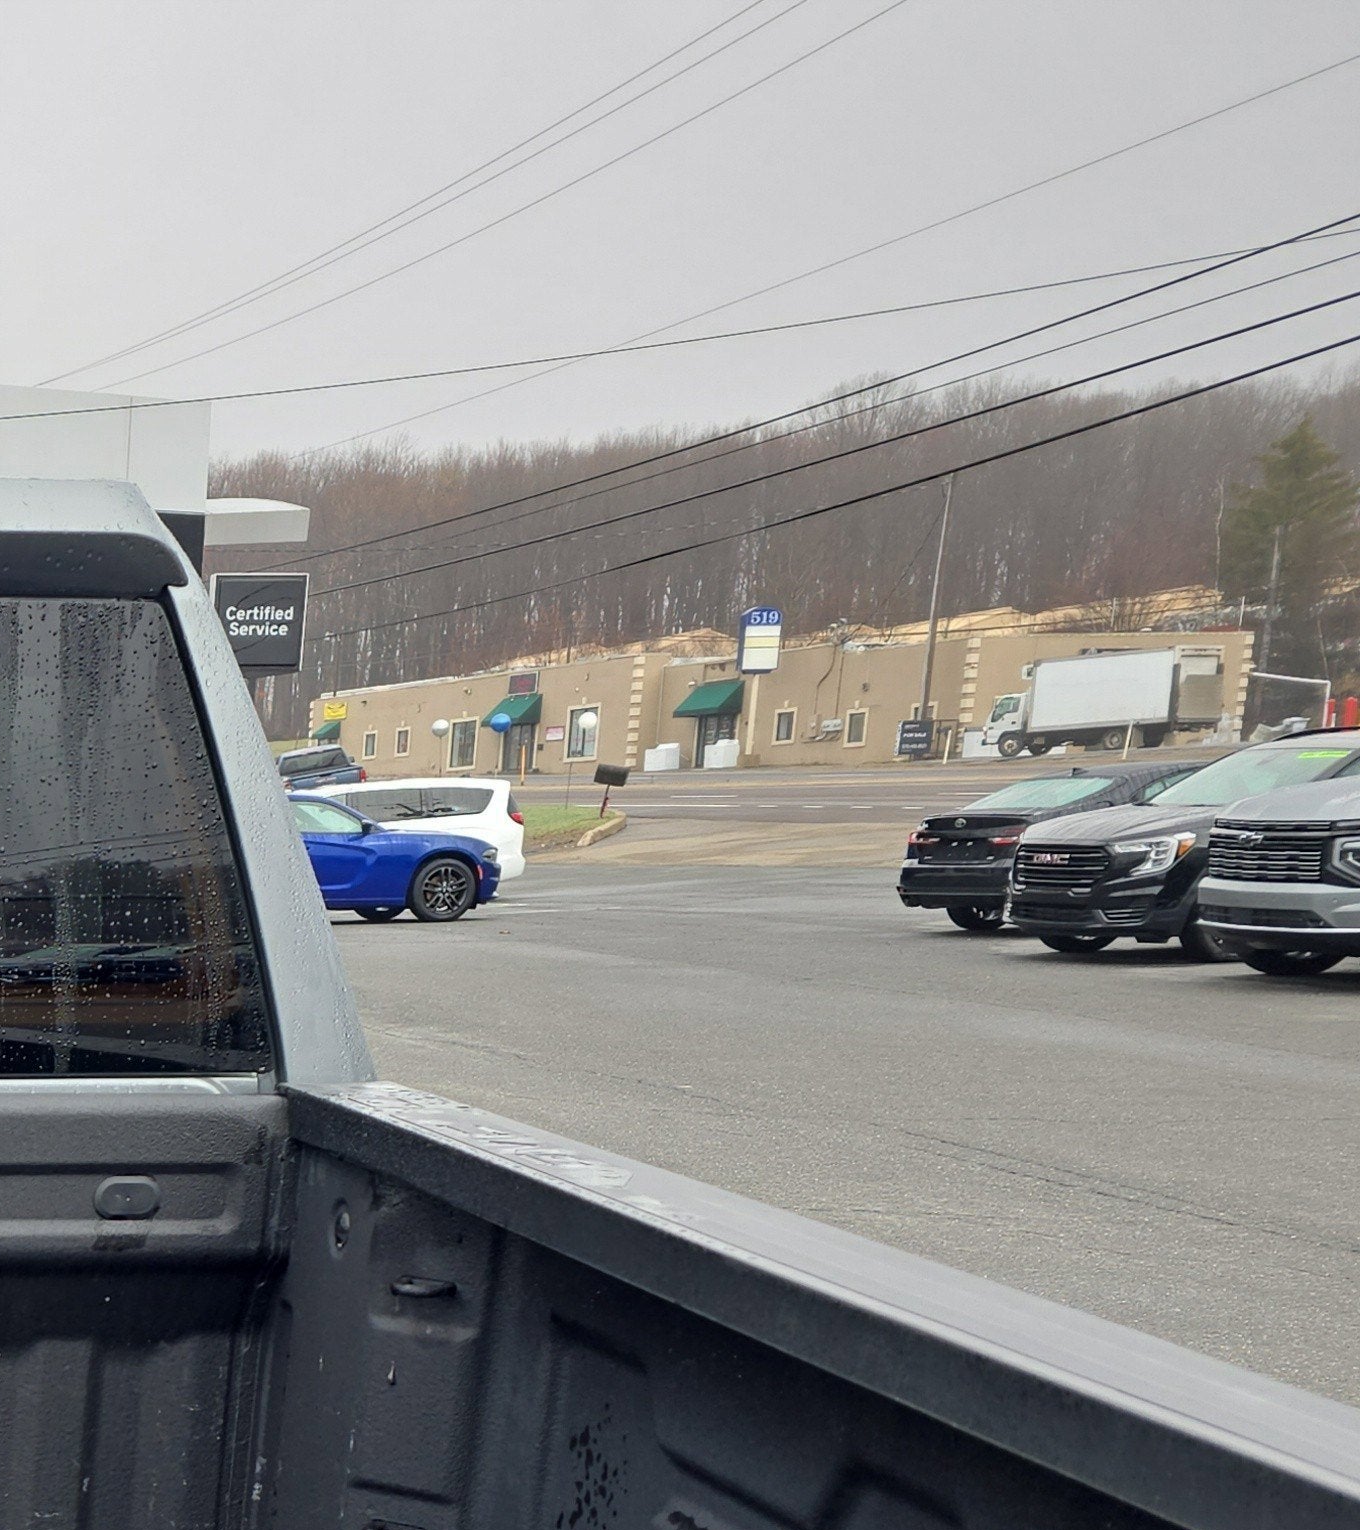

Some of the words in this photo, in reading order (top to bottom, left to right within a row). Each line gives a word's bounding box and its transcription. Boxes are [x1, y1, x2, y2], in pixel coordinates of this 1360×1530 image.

[225, 605, 294, 621] Certified
[750, 610, 779, 625] 519
[229, 621, 289, 636] Service
